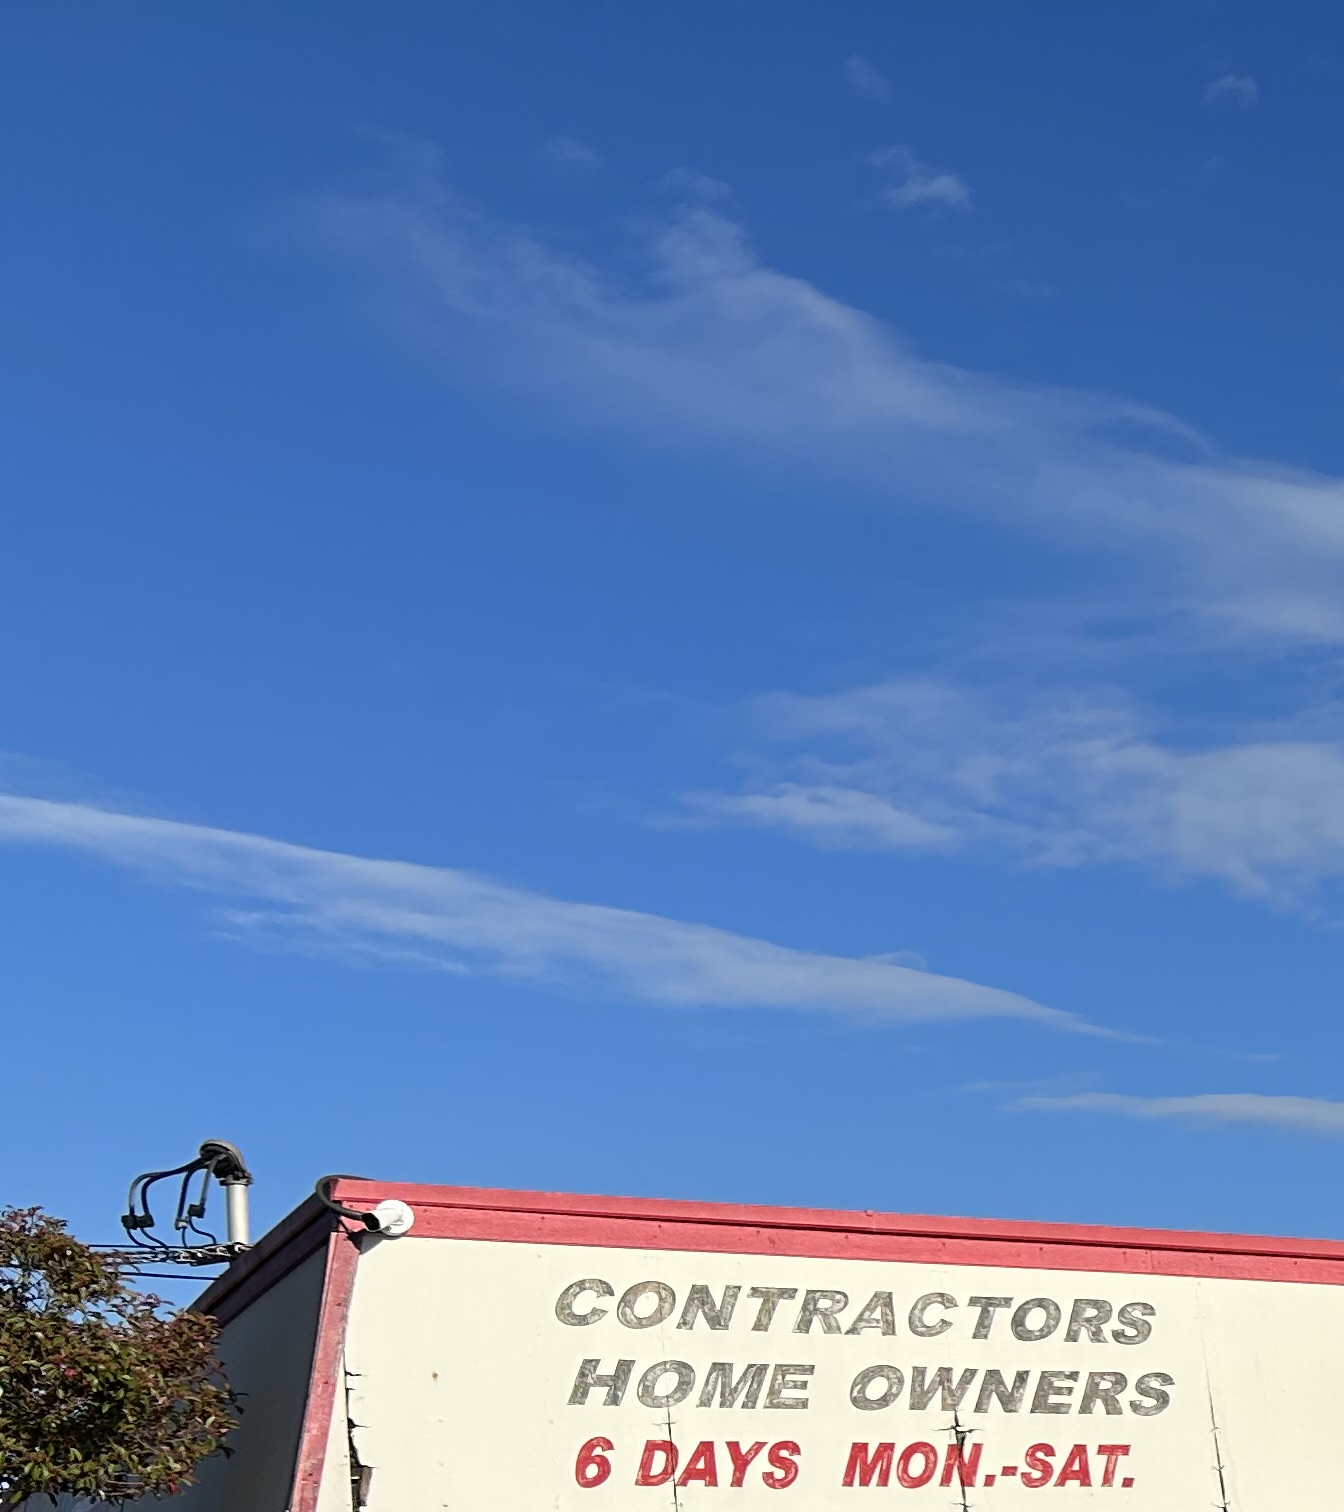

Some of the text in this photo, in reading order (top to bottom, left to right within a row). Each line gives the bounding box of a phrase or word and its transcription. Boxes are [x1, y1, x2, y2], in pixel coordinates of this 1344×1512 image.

[554, 1278, 1156, 1345] CONTRACTORS
[566, 1358, 1176, 1416] HOME OWNERS
[575, 1436, 1134, 1489] 6 DAYS MON.-SAT.
